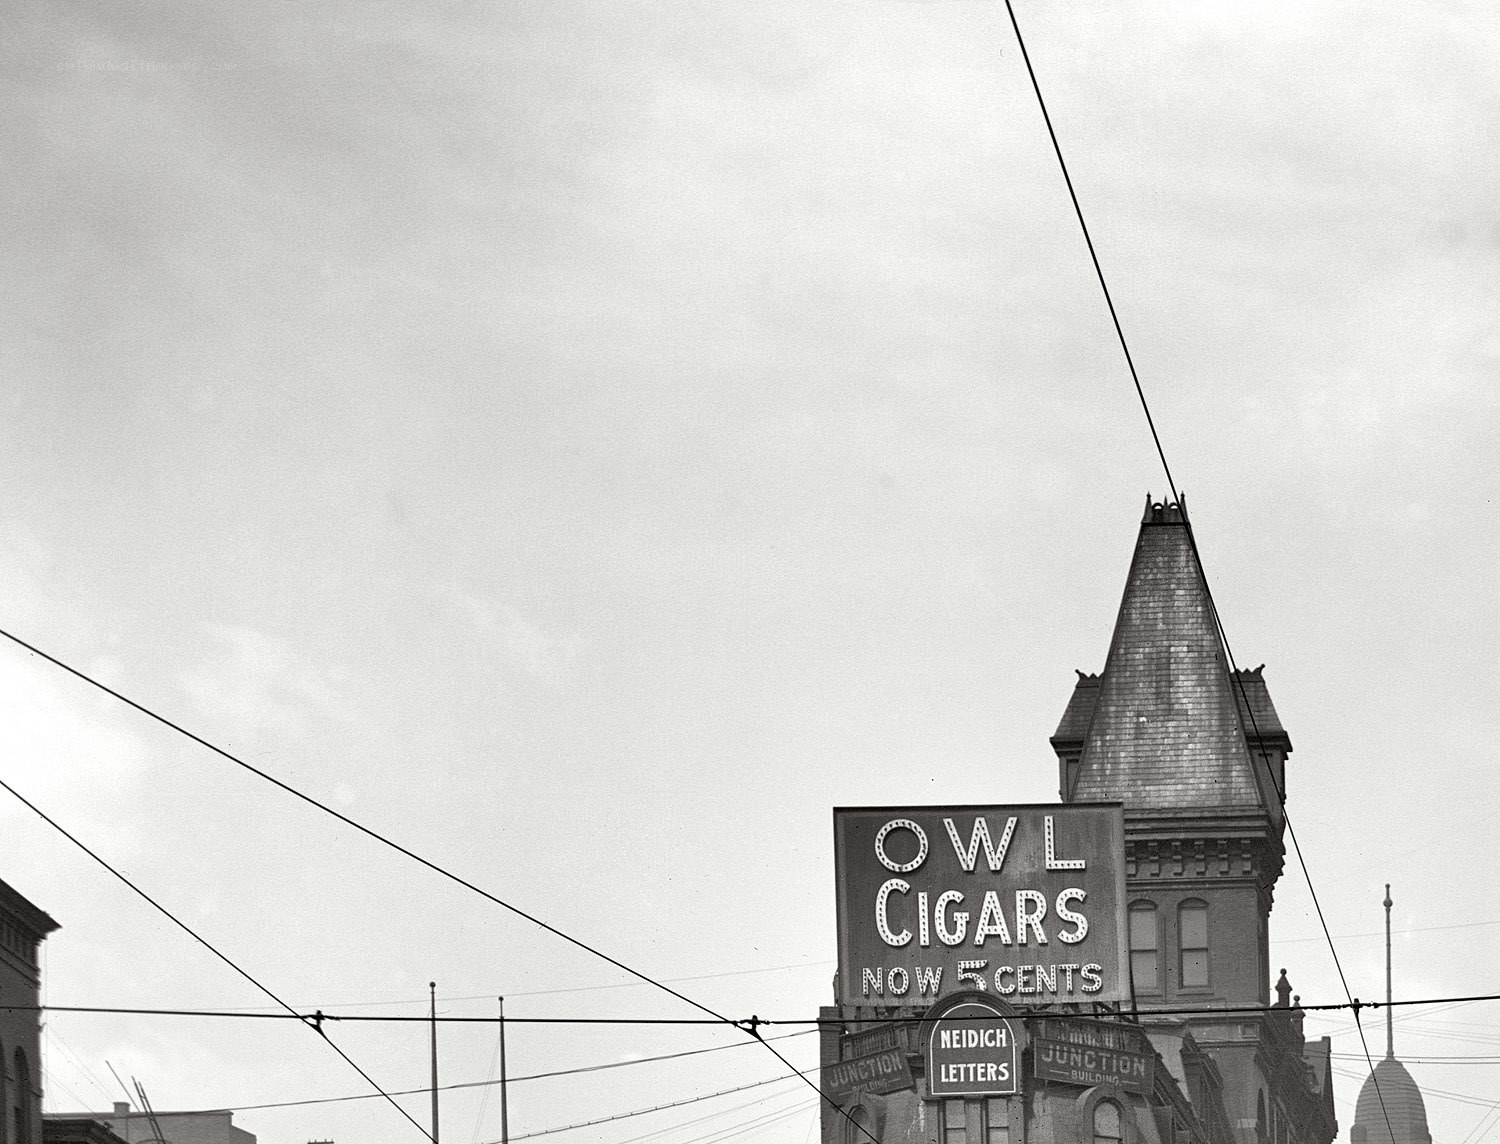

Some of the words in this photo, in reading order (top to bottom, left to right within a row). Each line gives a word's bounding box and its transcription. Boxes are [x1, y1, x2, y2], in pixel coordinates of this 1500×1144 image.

[874, 816, 1086, 872] OWL
[875, 878, 1089, 946] CIGARS
[862, 966, 943, 995] NOW
[957, 959, 988, 991] 5
[994, 964, 1102, 994] CENTS
[940, 1029, 1007, 1049] NEIDICH
[829, 1052, 903, 1088] JUNCTION
[940, 1062, 1010, 1083] LETTERS
[1041, 1044, 1146, 1077] JUNCTION
